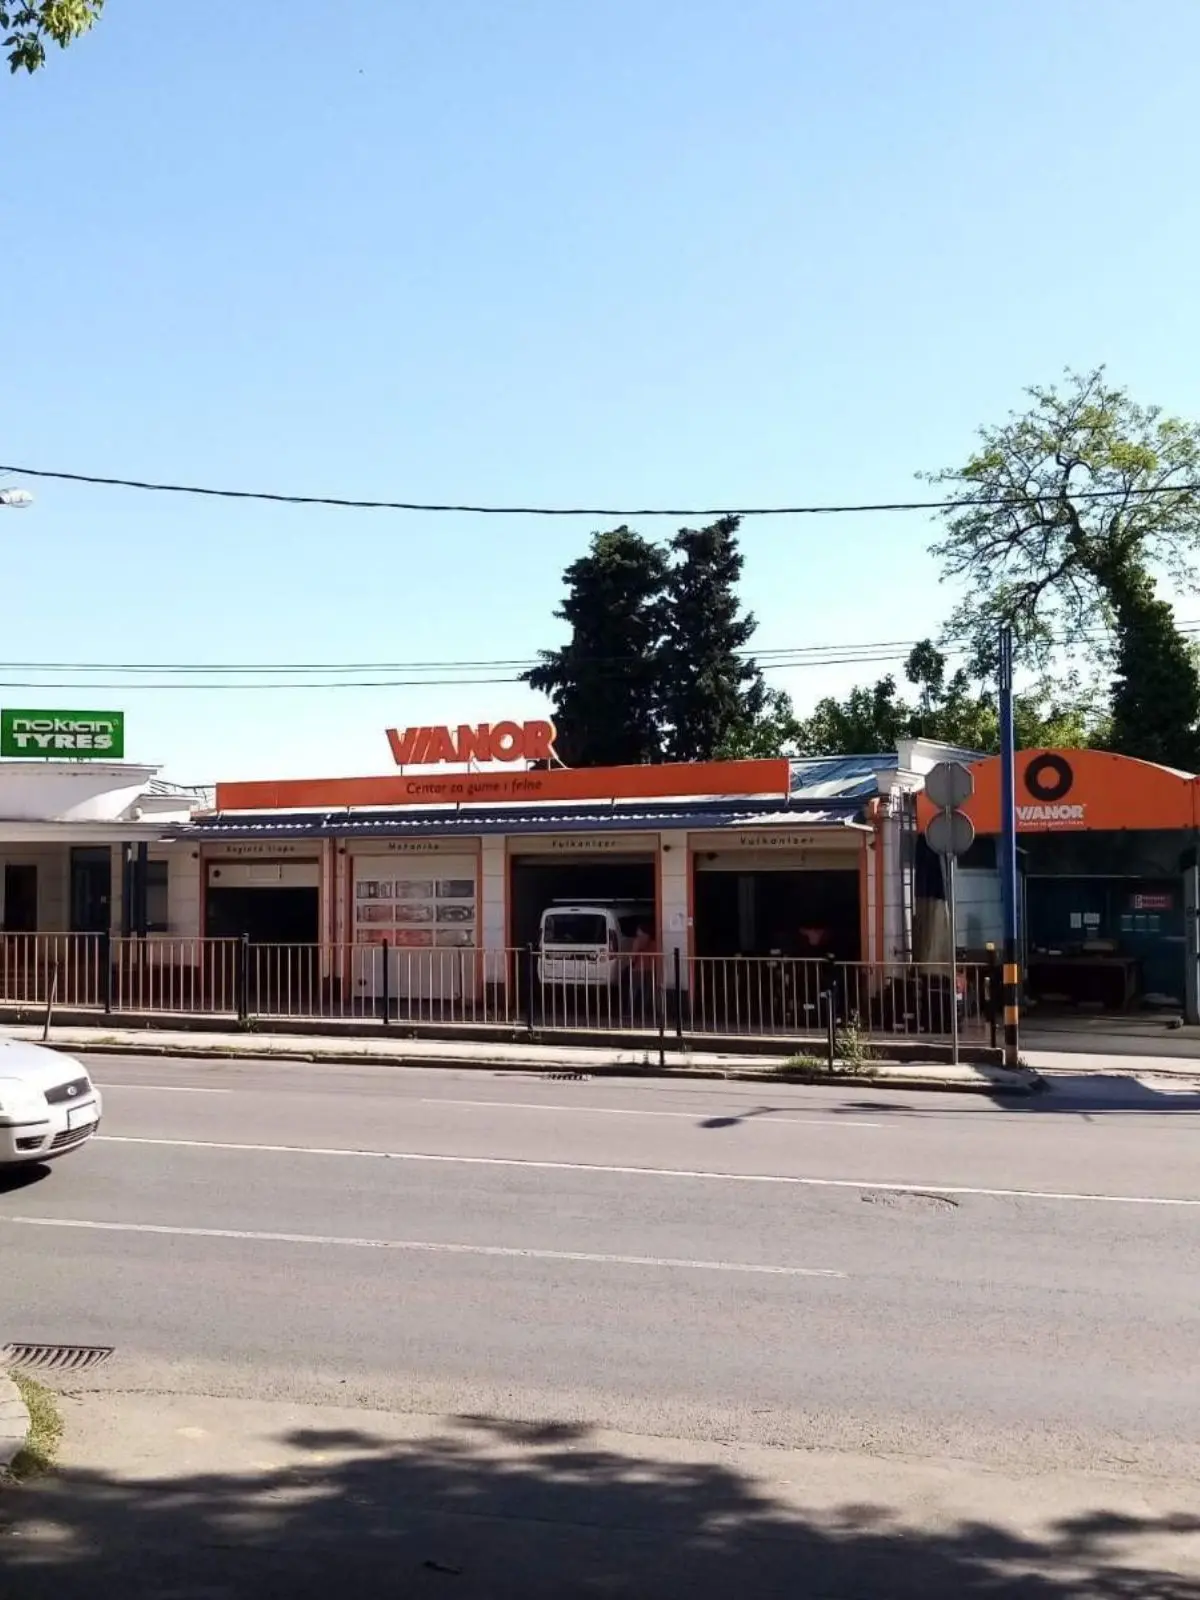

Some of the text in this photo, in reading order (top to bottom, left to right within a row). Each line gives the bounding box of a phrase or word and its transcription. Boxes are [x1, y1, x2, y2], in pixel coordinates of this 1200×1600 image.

[13, 733, 113, 749] TYRES
[385, 719, 556, 766] VIANOR
[406, 781, 446, 794] Centar
[451, 783, 464, 793] za
[467, 782, 500, 796] gume
[511, 778, 543, 794] felne
